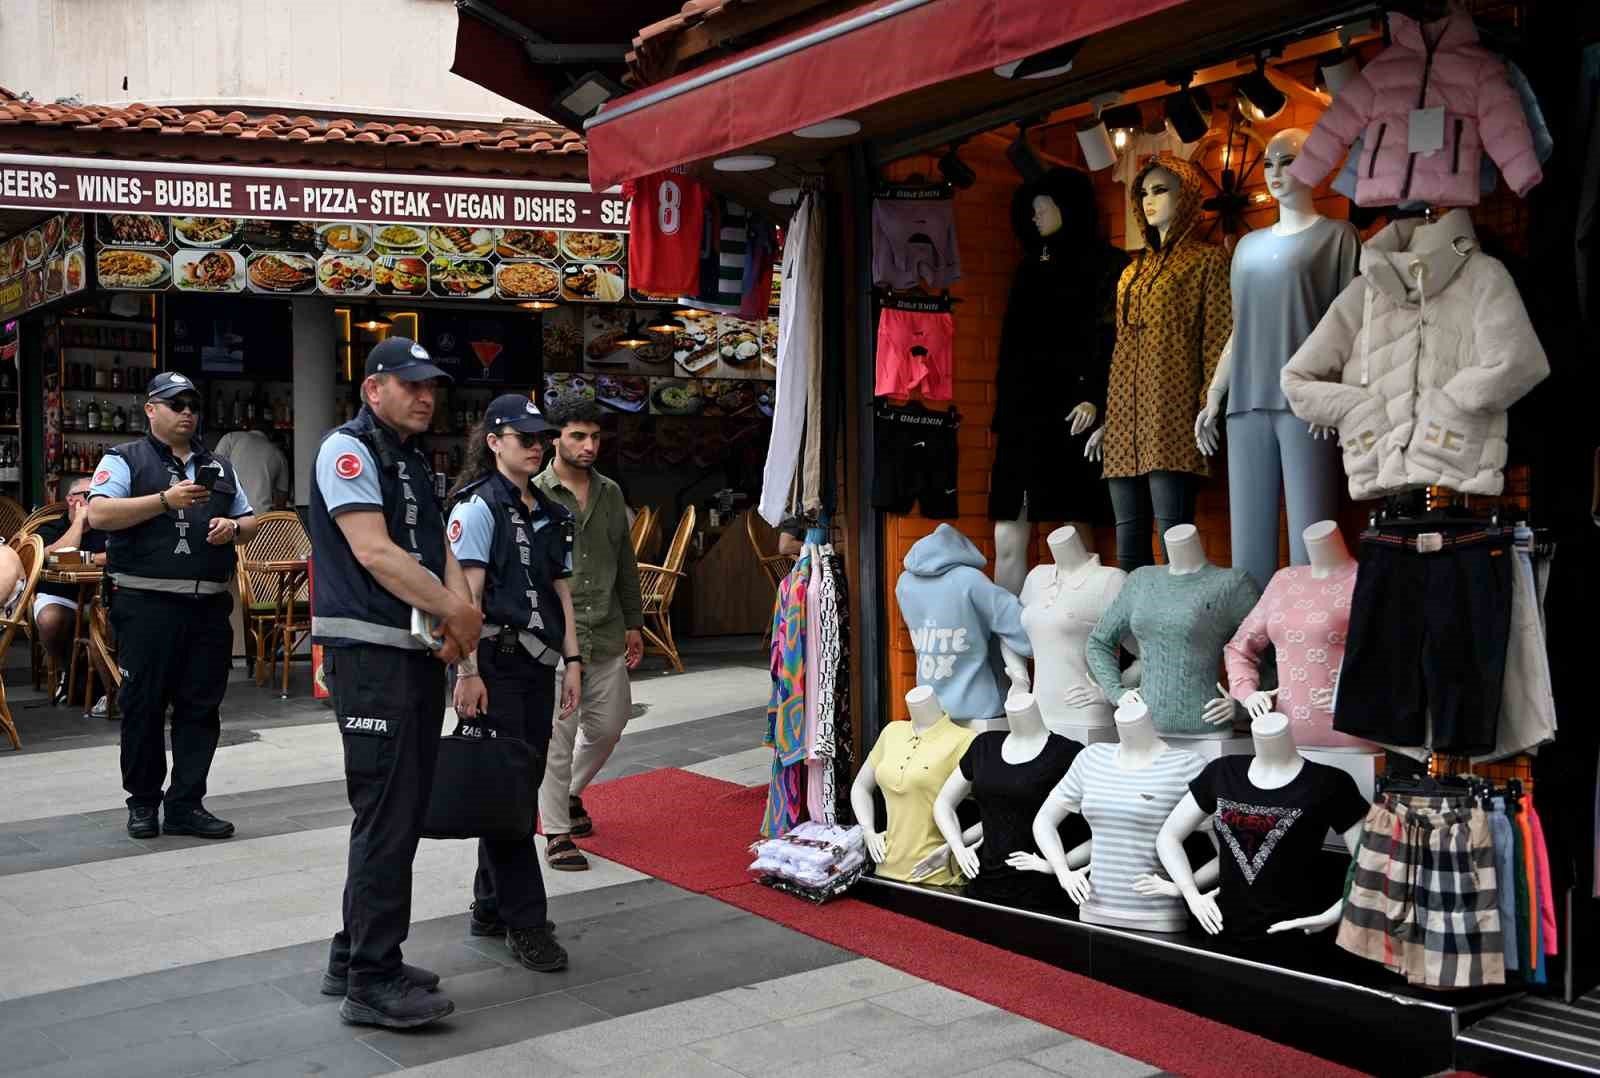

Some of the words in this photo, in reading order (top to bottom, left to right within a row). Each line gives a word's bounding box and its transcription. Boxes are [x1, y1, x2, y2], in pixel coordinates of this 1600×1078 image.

[514, 196, 577, 224] DISHES
[658, 180, 682, 235] 8
[397, 461, 423, 561] ZABI
[344, 717, 388, 732] ZABITA
